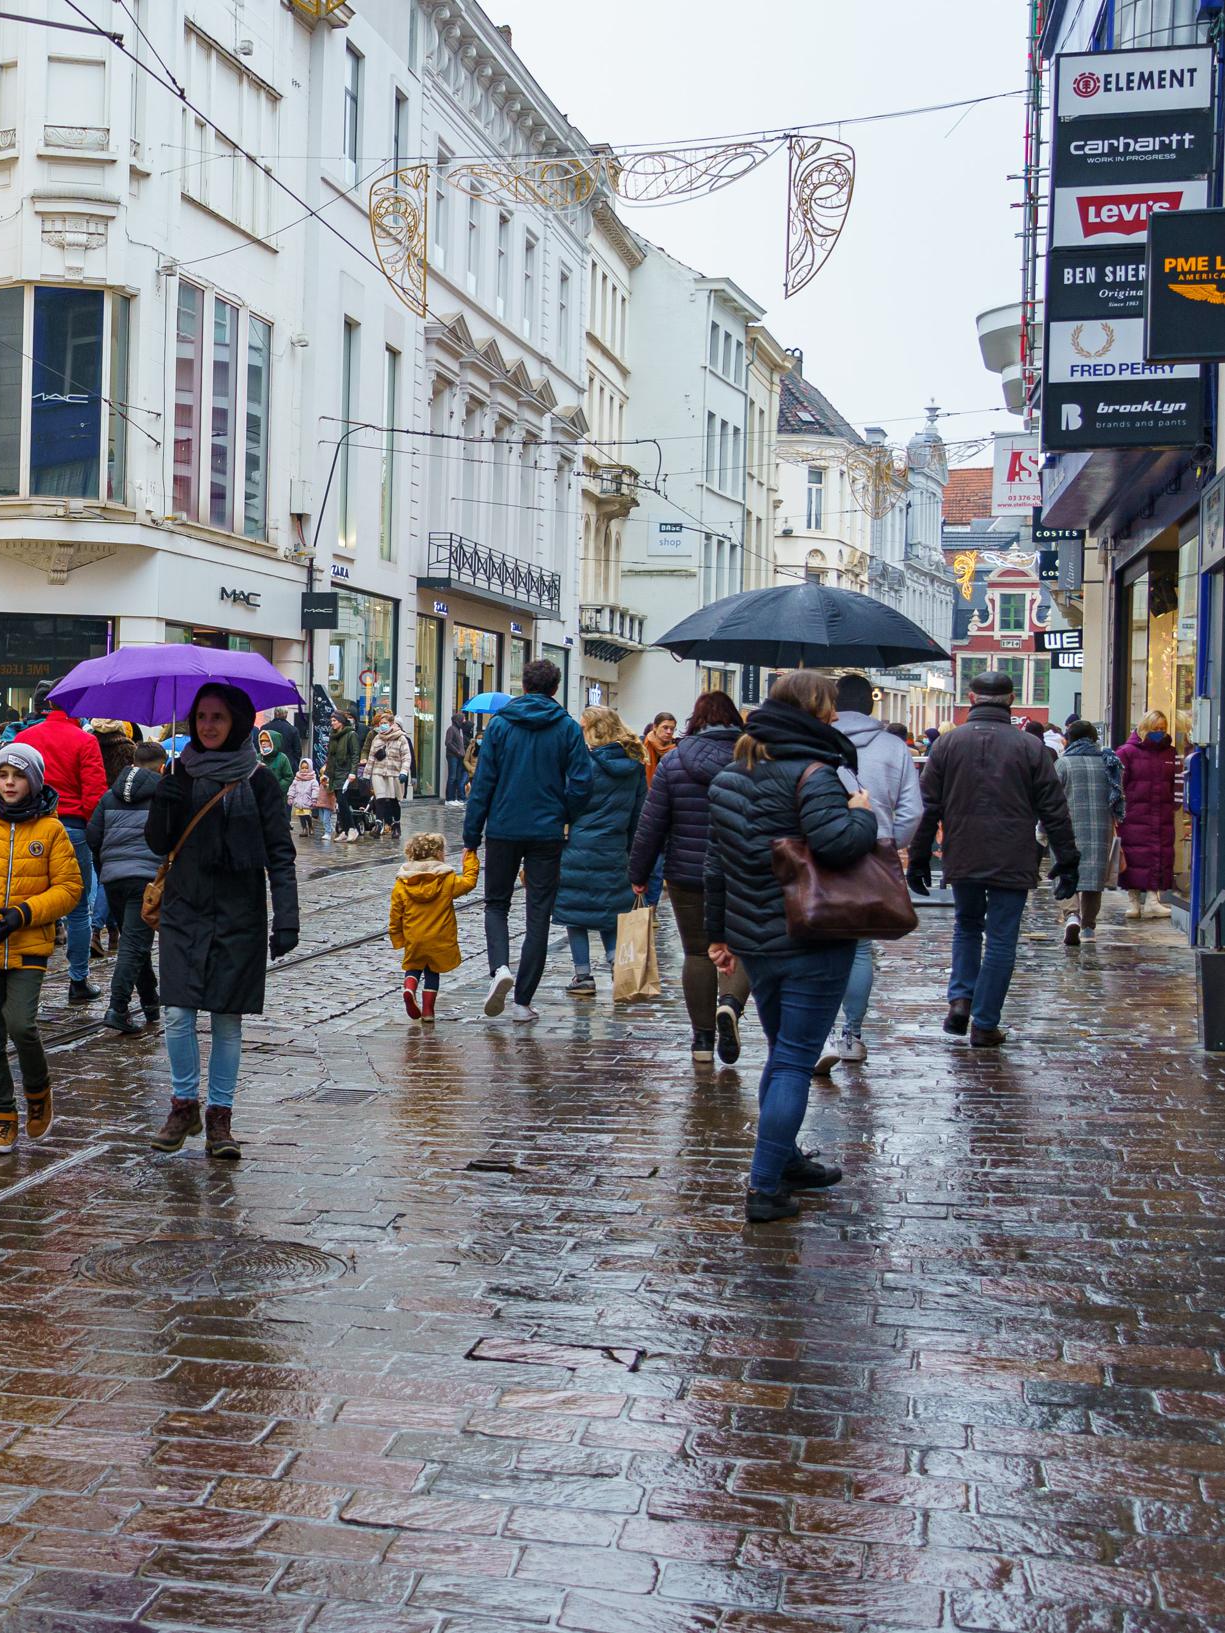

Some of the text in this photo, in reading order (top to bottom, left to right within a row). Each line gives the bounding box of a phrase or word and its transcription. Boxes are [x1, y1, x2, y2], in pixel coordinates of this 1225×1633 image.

[1103, 68, 1197, 93] ELEMENT
[1070, 132, 1195, 155] carhartt
[1126, 153, 1176, 162] PROGRESS
[1164, 256, 1209, 273] PME
[1063, 267, 1096, 285] BEN
[1070, 362, 1176, 377] FRED PERRY
[1096, 418, 1187, 429] brands and pants
[658, 538, 681, 549] shop
[220, 586, 262, 608] MAC
[1043, 632, 1080, 650] WE
[1058, 653, 1083, 668] WE
